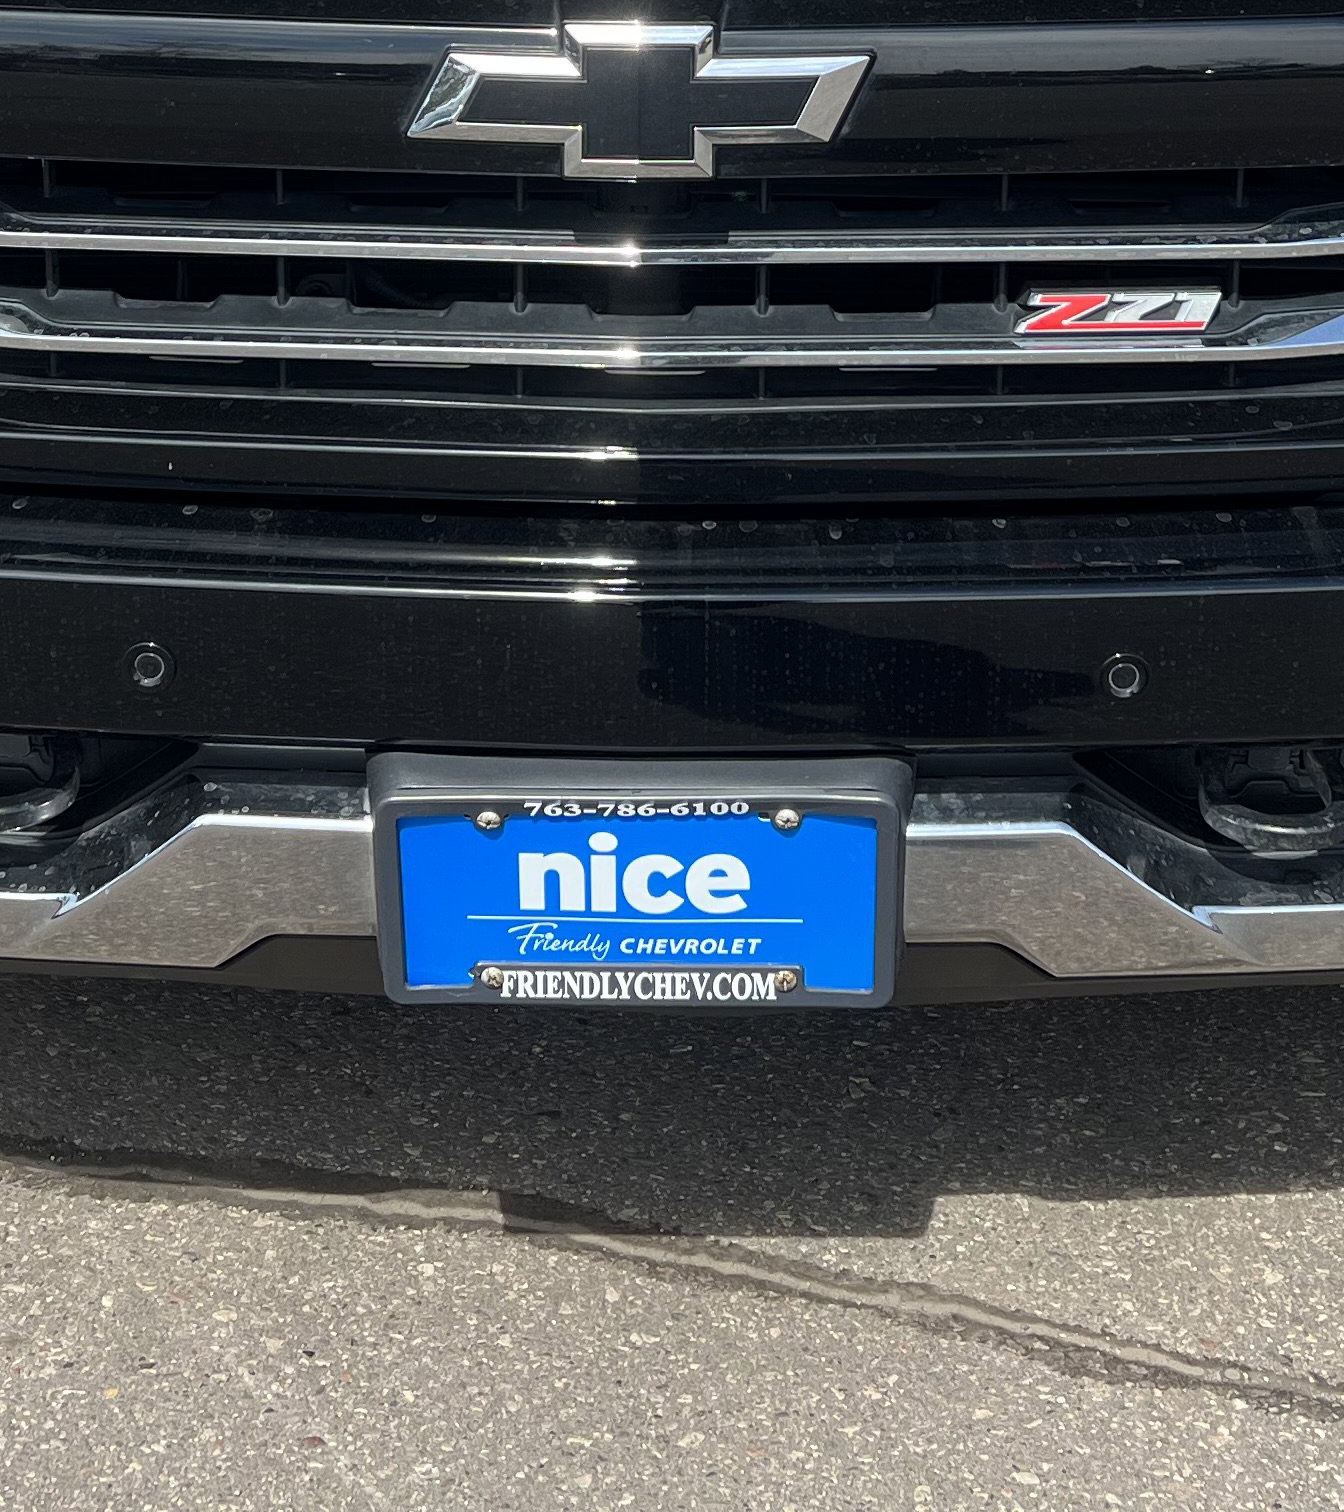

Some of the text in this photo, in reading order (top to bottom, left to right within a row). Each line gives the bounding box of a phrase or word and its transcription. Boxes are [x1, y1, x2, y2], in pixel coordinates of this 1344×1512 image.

[1014, 292, 1223, 334] Z71
[523, 801, 750, 818] 763-786-6100
[518, 831, 751, 914] nice
[507, 921, 762, 960] Friendly CHEVROLET
[500, 970, 777, 1000] FRIENDLYCHEV.COM
